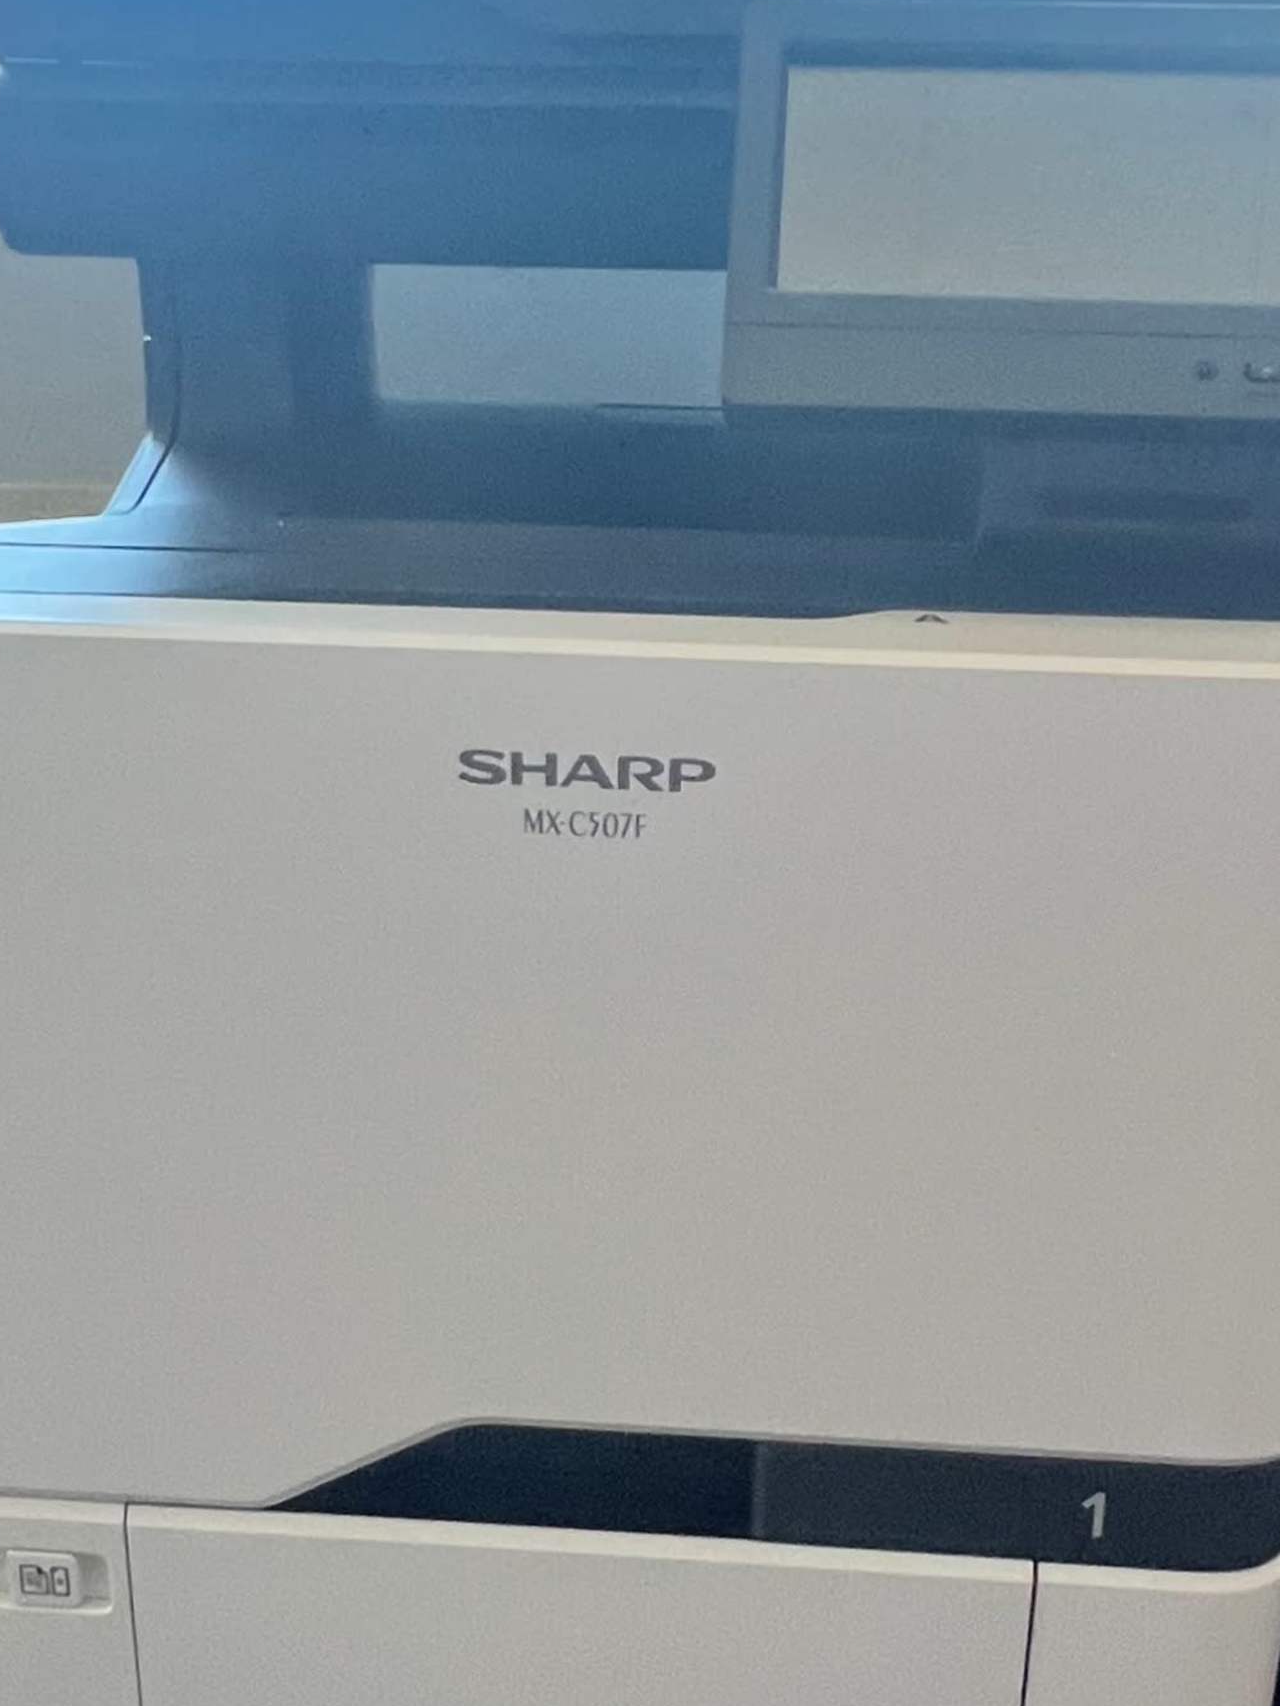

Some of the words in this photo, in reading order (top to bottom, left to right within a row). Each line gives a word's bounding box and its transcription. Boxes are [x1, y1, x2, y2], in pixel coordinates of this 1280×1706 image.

[458, 749, 716, 793] SHARP
[523, 808, 647, 839] MX-C507F
[1081, 1492, 1107, 1540] 1
